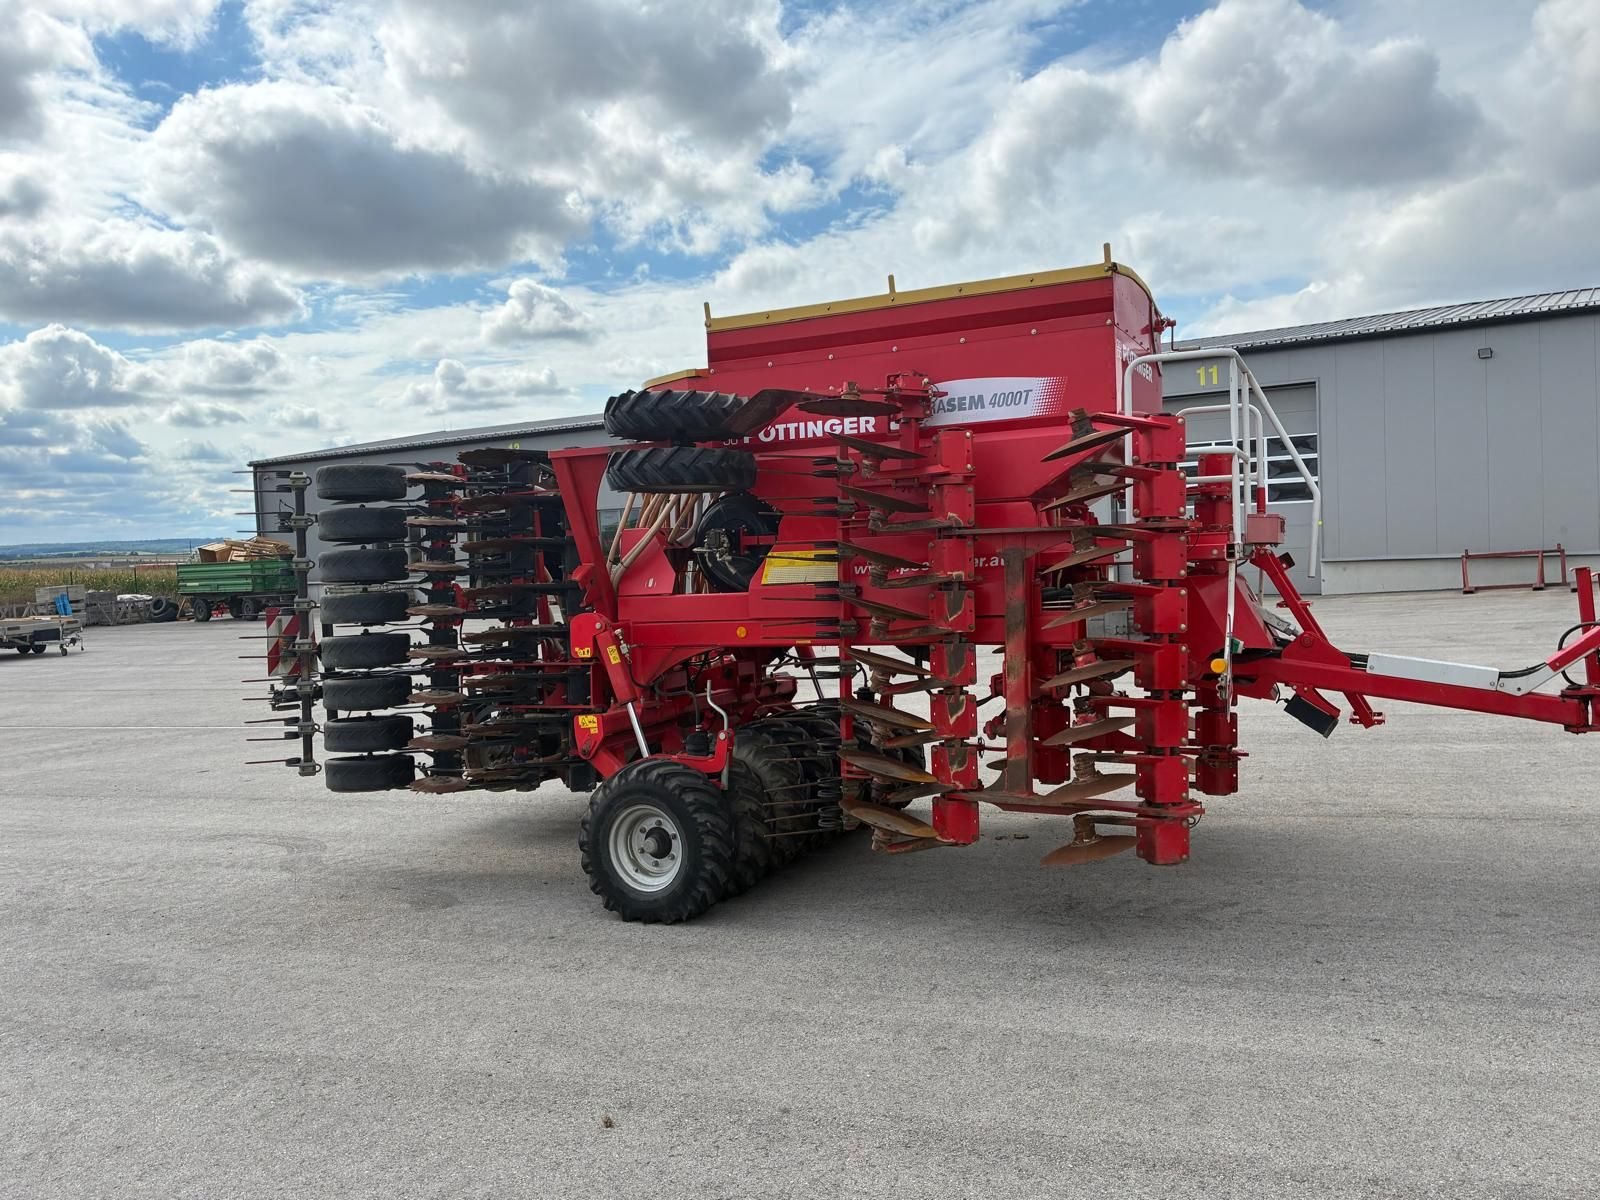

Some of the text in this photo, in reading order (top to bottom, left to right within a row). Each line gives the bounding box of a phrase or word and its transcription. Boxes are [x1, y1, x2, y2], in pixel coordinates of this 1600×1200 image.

[1196, 365, 1218, 386] 11
[931, 389, 1033, 414] ASEM 4000T
